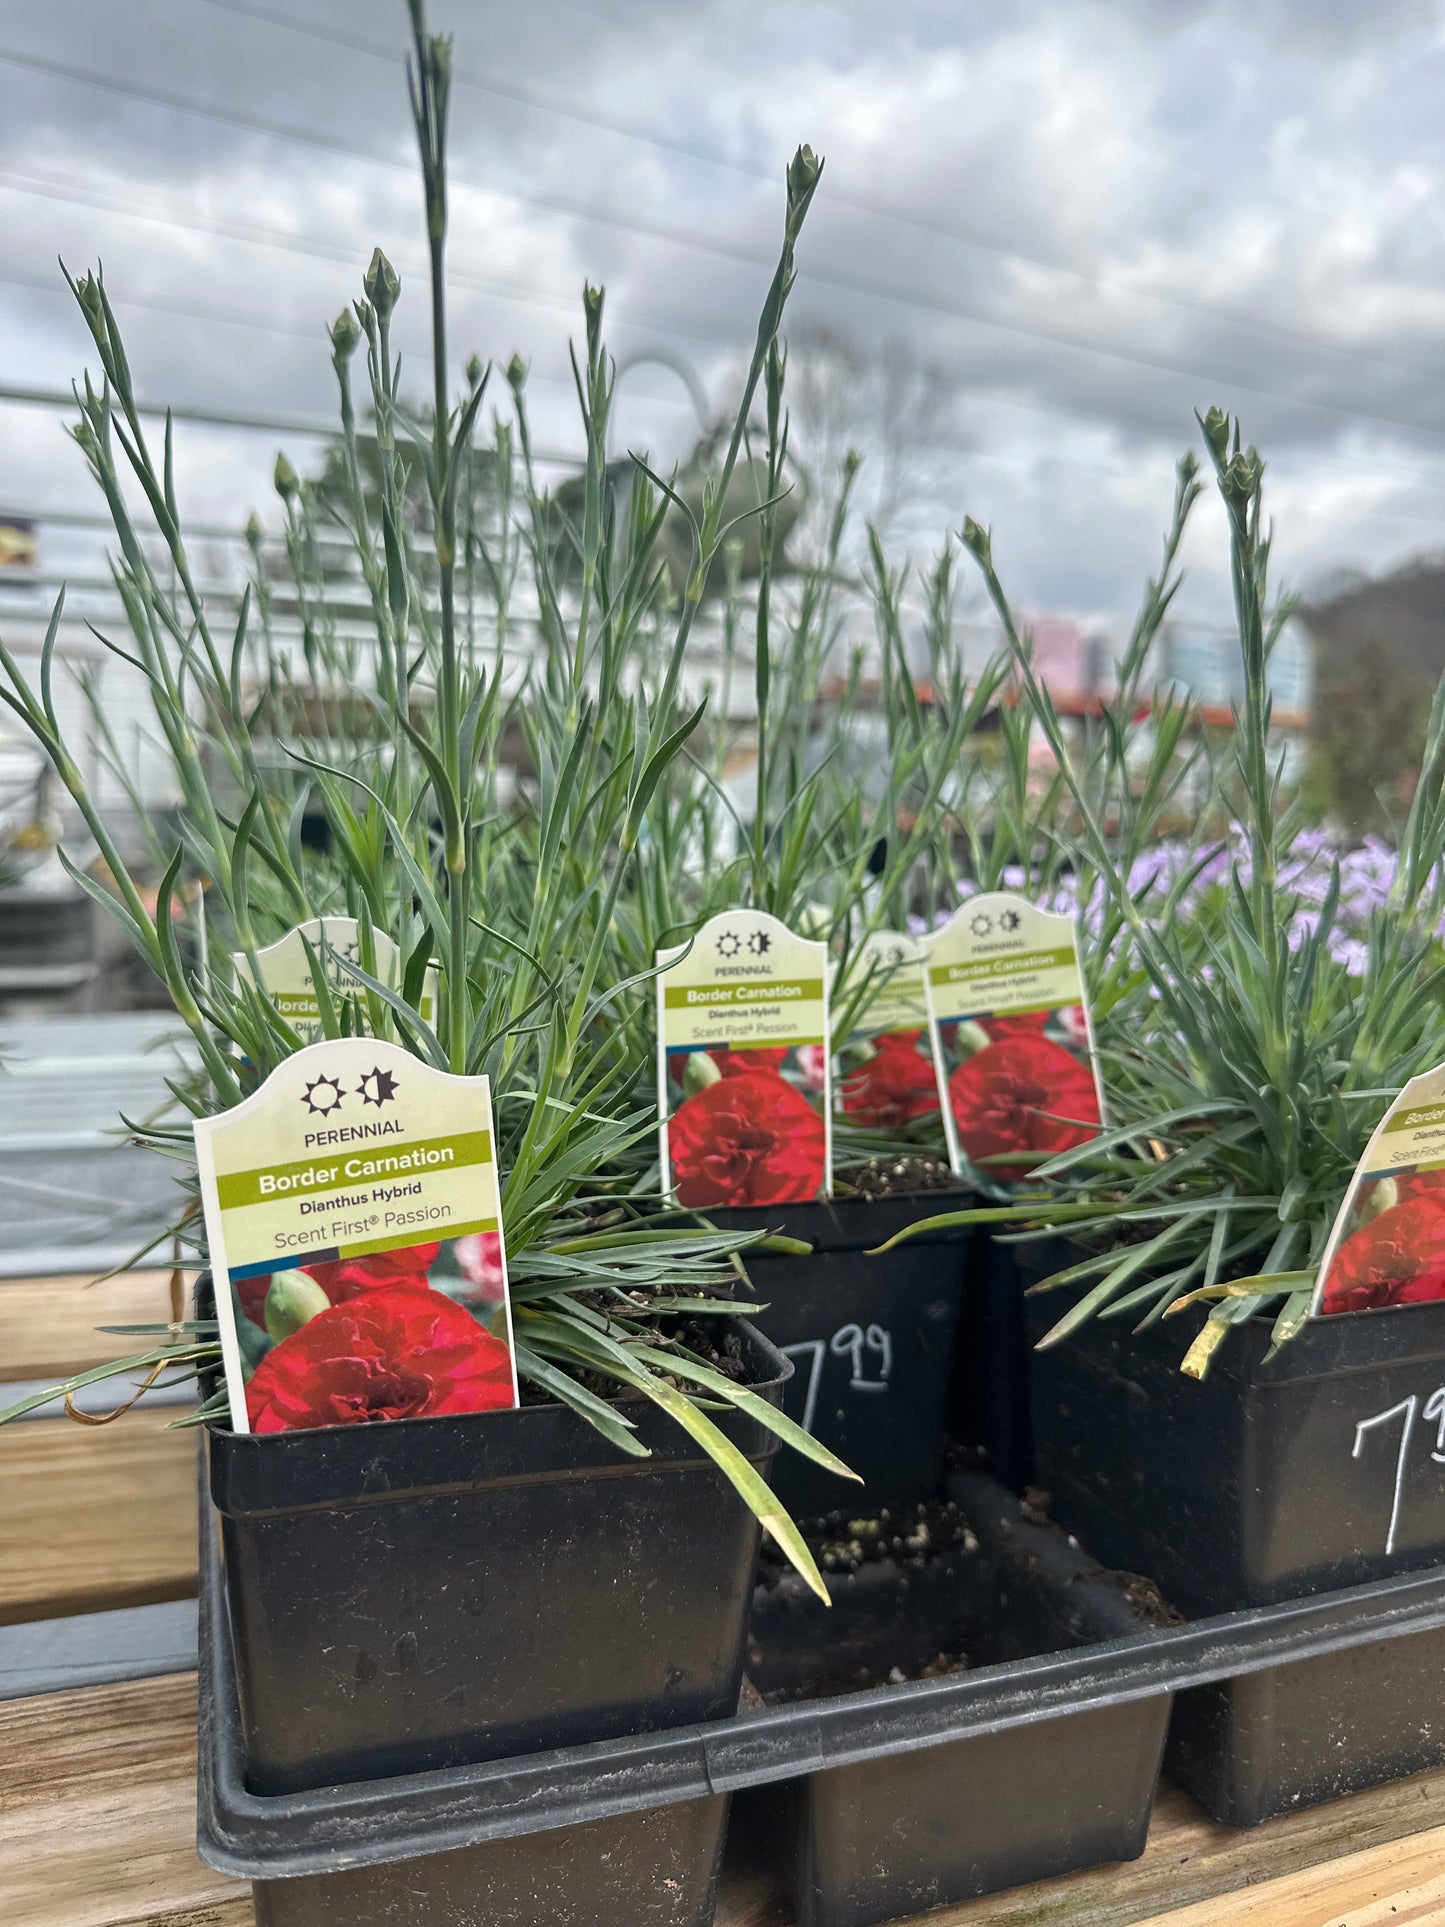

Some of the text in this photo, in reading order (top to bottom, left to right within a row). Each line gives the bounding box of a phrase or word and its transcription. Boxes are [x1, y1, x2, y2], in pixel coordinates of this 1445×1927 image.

[715, 966, 772, 977] PERENNIAL
[948, 954, 1056, 979] Border Carnation
[687, 985, 801, 1002] Border Carnation
[708, 1006, 780, 1019] Dianthus Hybrid
[692, 1027, 723, 1038] Scent
[756, 1022, 798, 1034] Passion
[1404, 1109, 1445, 1125] Border
[304, 1119, 404, 1148] PERENNIAL
[1390, 1149, 1419, 1162] Scent
[258, 1147, 454, 1194] Border Carnation
[299, 1182, 422, 1215] Dianthus Hybrid
[274, 1225, 327, 1249] Scent
[384, 1205, 451, 1228] Passion
